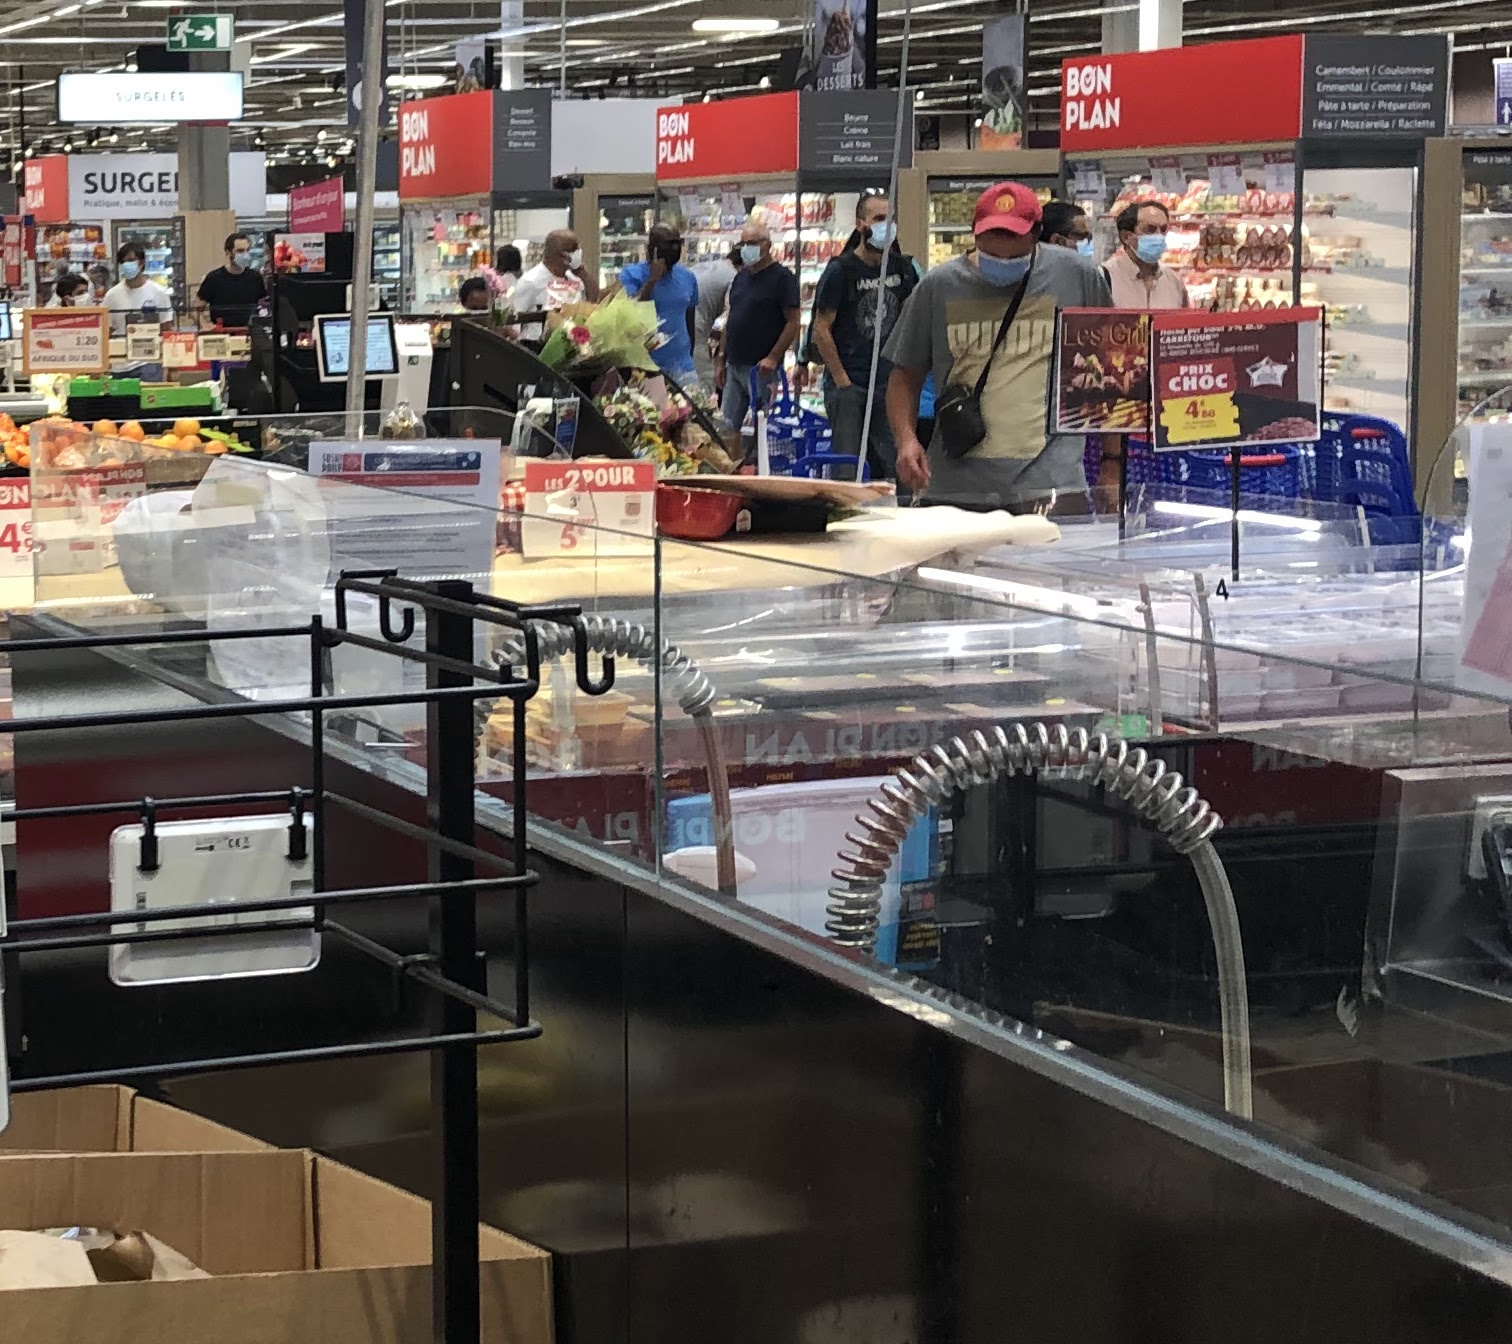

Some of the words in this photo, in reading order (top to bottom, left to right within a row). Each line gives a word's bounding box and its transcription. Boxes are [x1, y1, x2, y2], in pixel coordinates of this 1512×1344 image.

[1066, 63, 1112, 97] BON
[1316, 65, 1370, 76] Camembert
[1317, 81, 1363, 92] Emmental
[402, 110, 429, 143] BON
[659, 111, 689, 138] BON
[1066, 98, 1120, 131] PLAN
[402, 144, 435, 177] PLAN
[659, 138, 695, 164] PLAN
[1064, 321, 1102, 347] Les
[1168, 373, 1228, 392] CHOC
[1179, 363, 1214, 376] PRIX
[545, 477, 563, 491] LES
[565, 469, 581, 491] 2
[583, 466, 636, 486] POUR
[1215, 578, 1230, 601] 4
